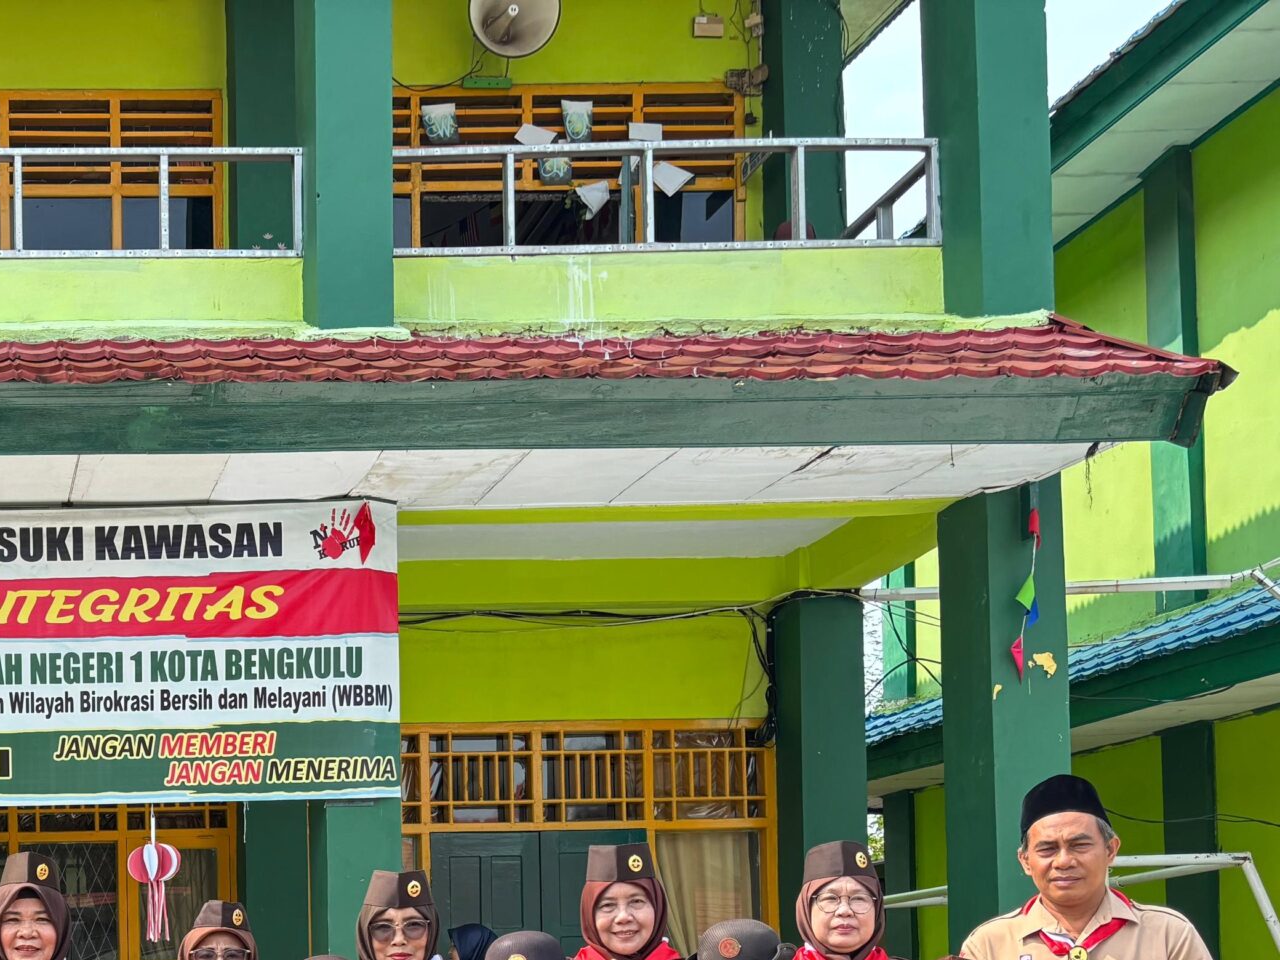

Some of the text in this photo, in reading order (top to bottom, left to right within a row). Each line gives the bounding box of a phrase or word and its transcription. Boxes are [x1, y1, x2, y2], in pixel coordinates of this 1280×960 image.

[95, 522, 283, 561] KAWASAN
[30, 651, 124, 685] NEGERI
[130, 651, 143, 683] 1
[150, 649, 219, 683] KOTA
[225, 646, 363, 681] BENGKULU
[9, 690, 74, 719] Wilayah
[80, 689, 155, 713] Birokrasi
[160, 687, 213, 711] Bersih
[218, 687, 248, 711] dan
[254, 685, 326, 714] Melayani
[332, 684, 393, 713] (WBBM)
[55, 732, 276, 760] JANGAN MEMBERI
[165, 757, 396, 785] JANGAN MENERIMA
